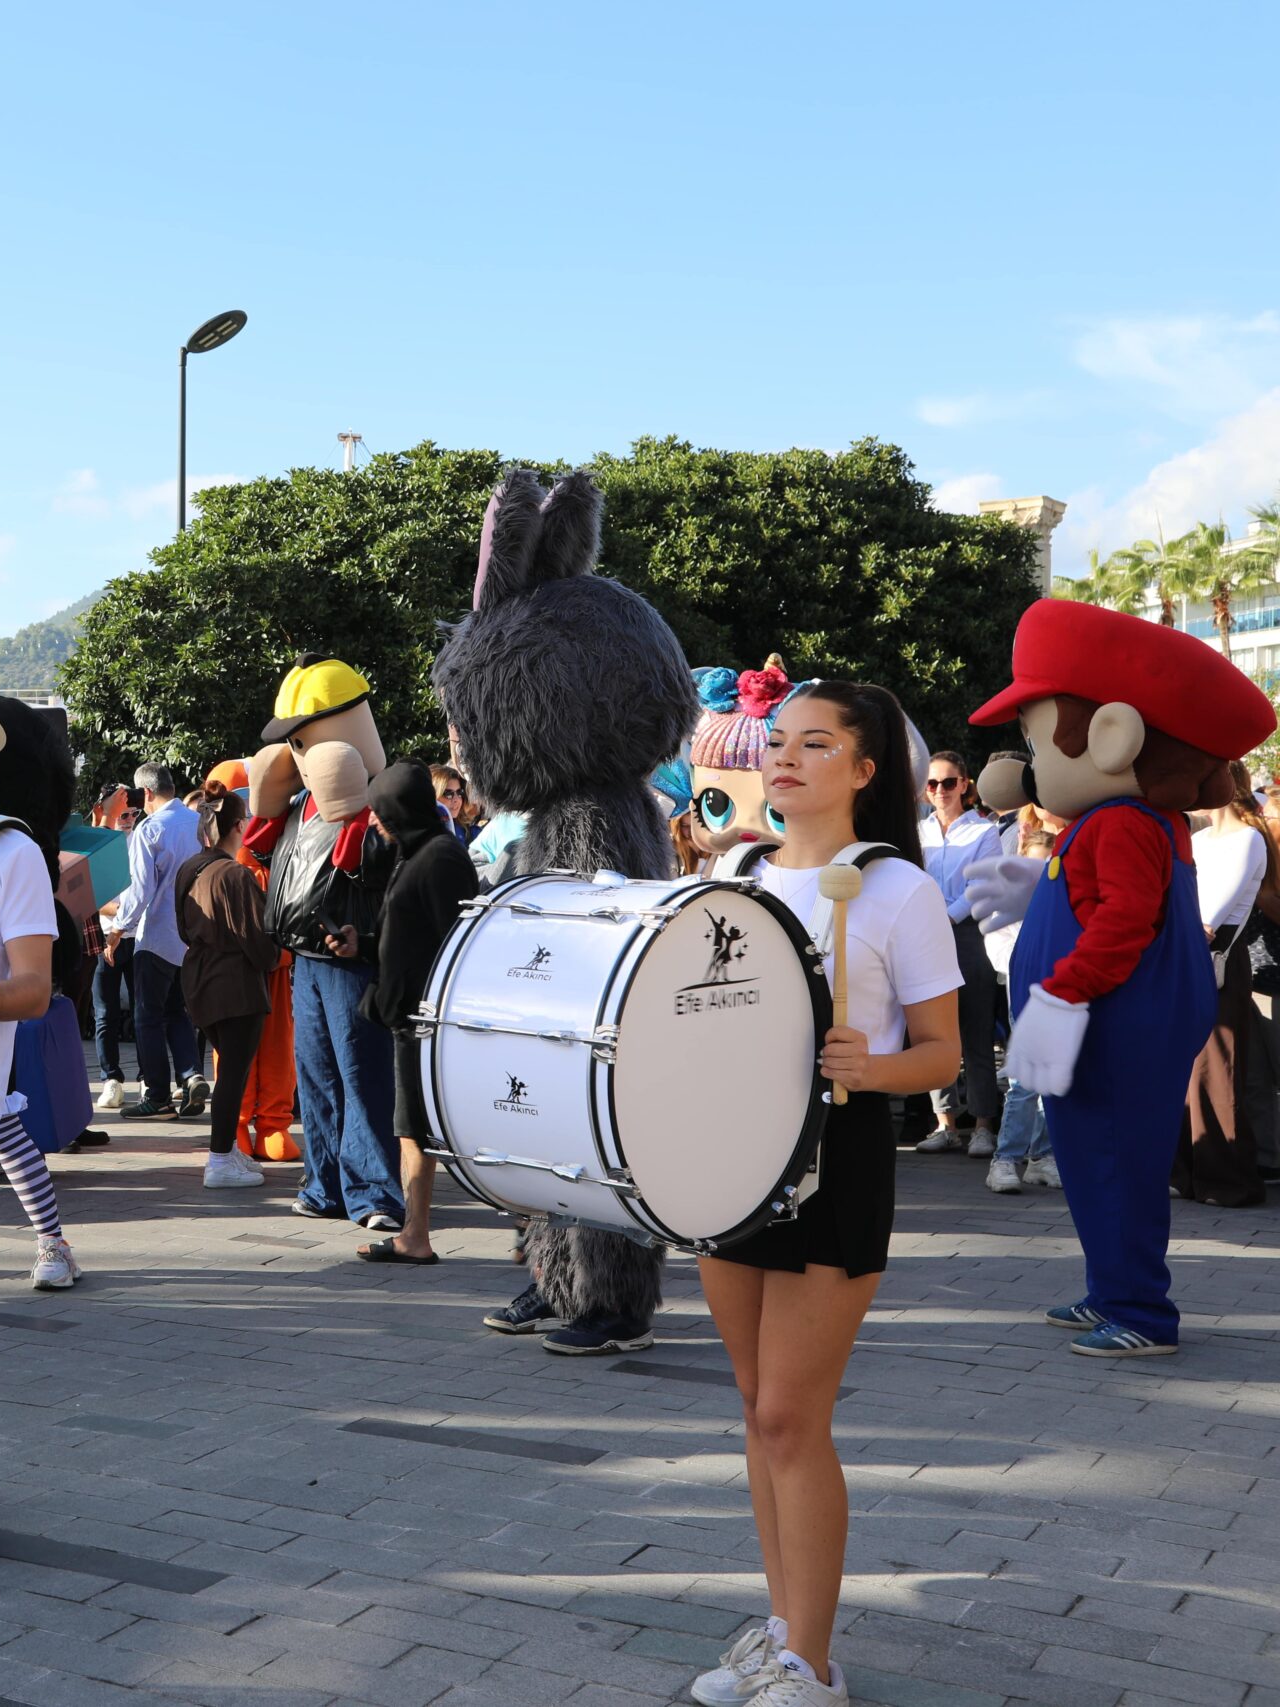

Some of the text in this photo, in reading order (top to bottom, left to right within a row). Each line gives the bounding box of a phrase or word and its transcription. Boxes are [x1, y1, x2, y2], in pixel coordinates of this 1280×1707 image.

[507, 968, 521, 979] Efe
[674, 992, 703, 1015] Efe
[493, 1101, 508, 1112] Efe
